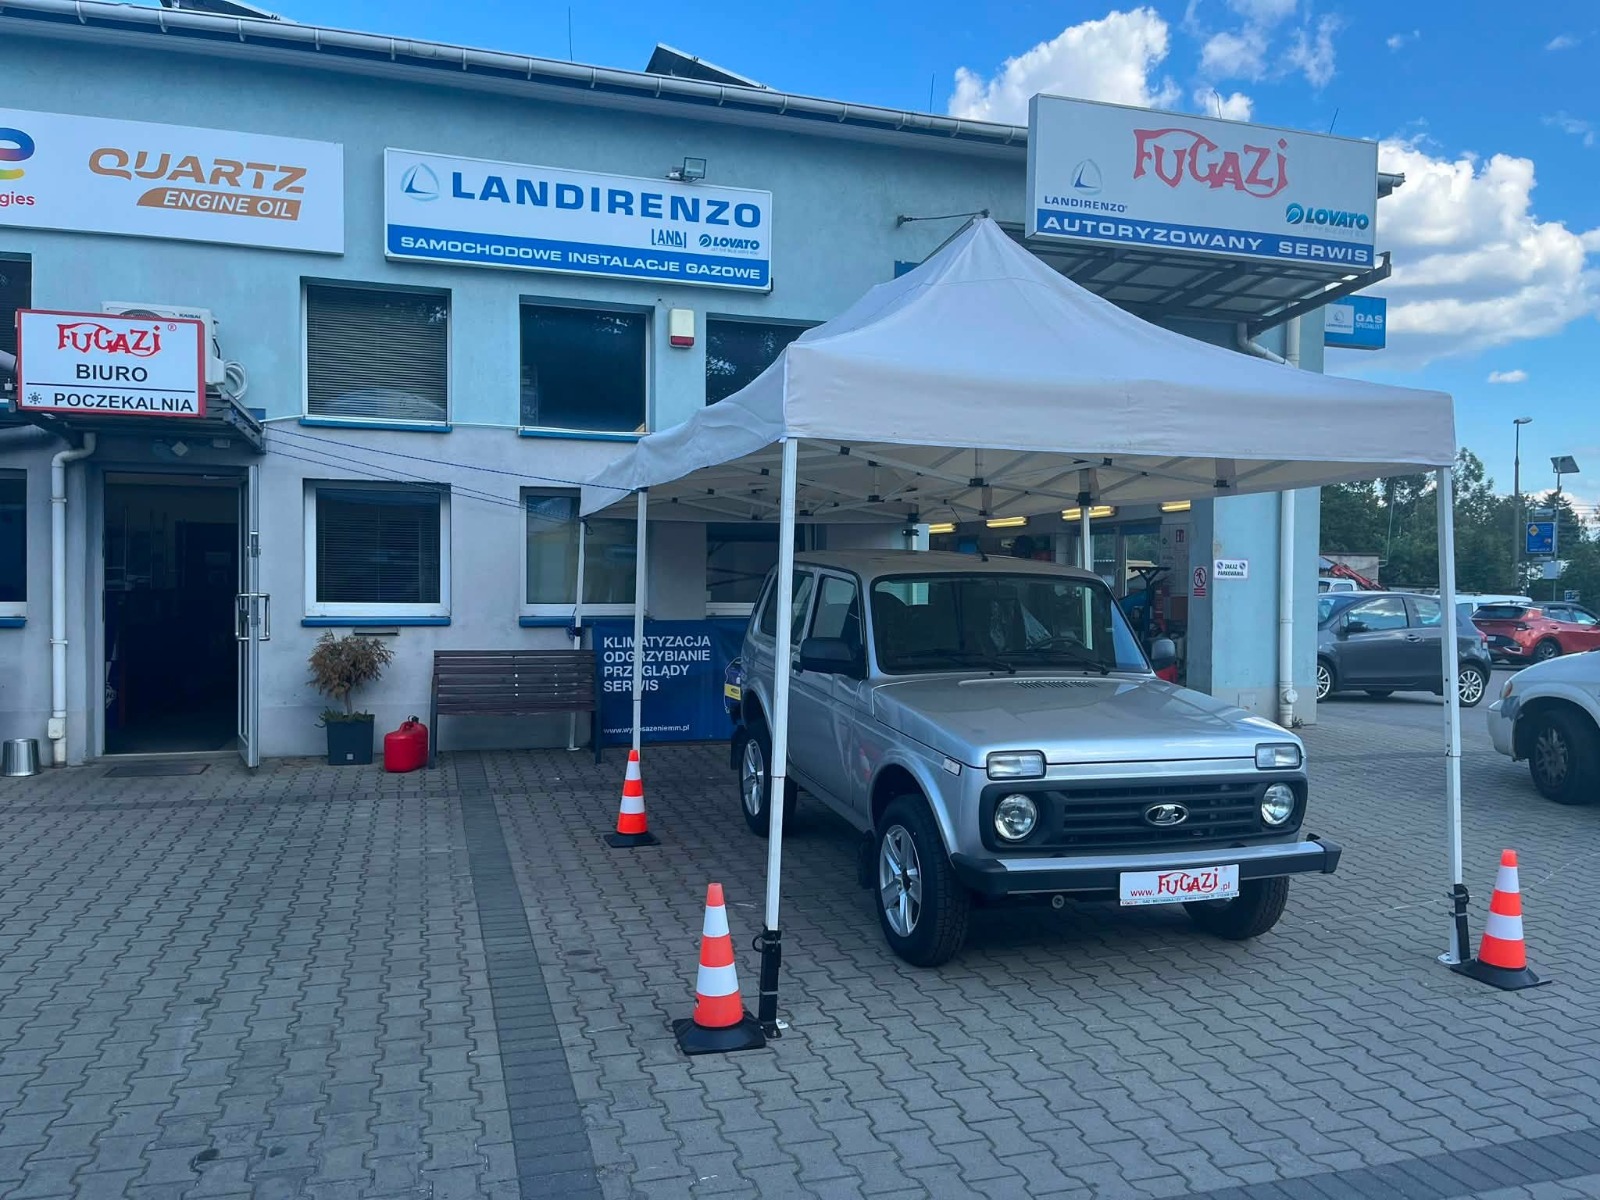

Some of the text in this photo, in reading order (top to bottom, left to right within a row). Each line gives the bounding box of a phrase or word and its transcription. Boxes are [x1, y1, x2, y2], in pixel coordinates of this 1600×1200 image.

[88, 147, 307, 194] QUARTZ
[163, 190, 293, 218] ENGINE OIL
[451, 171, 762, 229] LANDIRENZO
[1044, 195, 1126, 213] LANDIRENZO
[1305, 207, 1370, 230] LOVATO
[712, 237, 760, 250] LOVATO
[1043, 216, 1368, 262] AUTORYZOWANY SERWIS
[400, 235, 760, 279] SAMOCHODOWE INSTALACJE GAZOWE
[1355, 313, 1383, 324] GAS
[76, 363, 148, 382] BIURO
[54, 392, 194, 412] POCZEKALNIA
[603, 664, 690, 679] PRZGLĄDY
